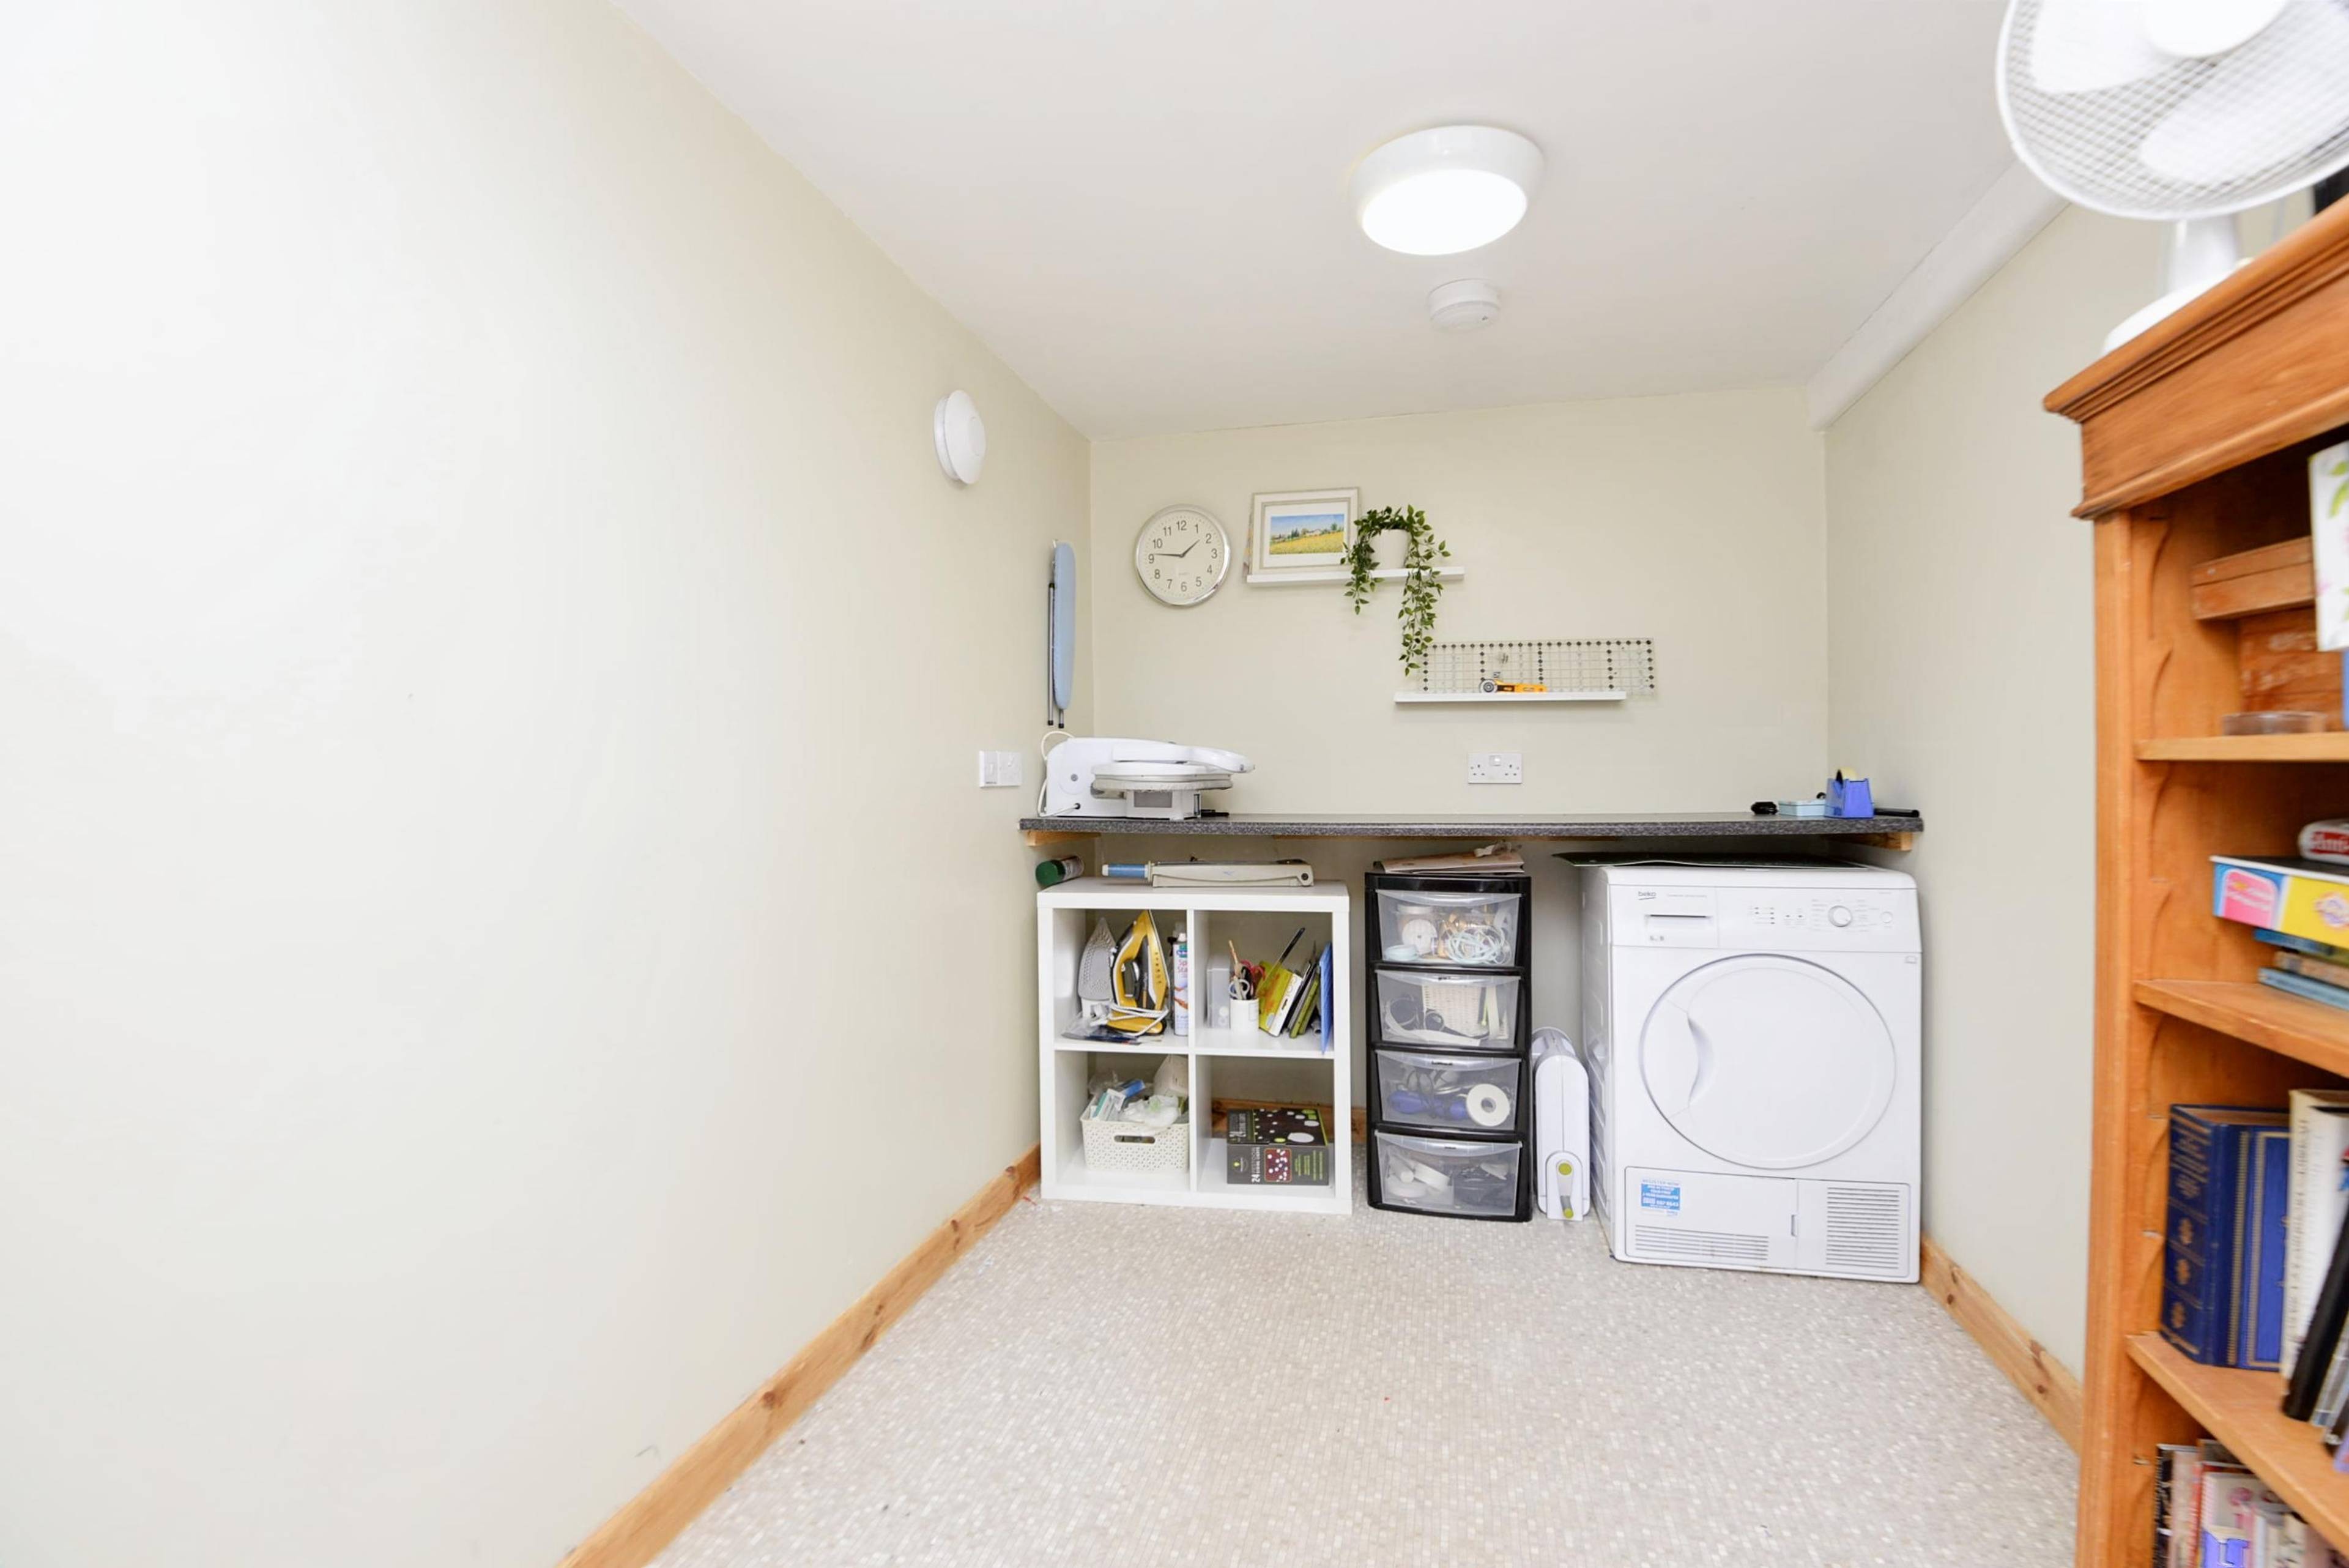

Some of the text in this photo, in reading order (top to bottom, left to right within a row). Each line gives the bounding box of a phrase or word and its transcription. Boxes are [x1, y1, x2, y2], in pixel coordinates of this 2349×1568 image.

[1176, 520, 1187, 531] 12
[1195, 524, 1199, 533] 1
[1163, 526, 1171, 536] 11
[1152, 538, 1163, 549] 10
[1205, 533, 1212, 544] 2
[1211, 548, 1218, 559] 3
[1148, 554, 1155, 564] 9
[1154, 568, 1161, 579] 8
[1206, 565, 1212, 574] 4
[1167, 579, 1173, 589] 7
[1195, 576, 1202, 587] 5
[1181, 582, 1187, 592] 6
[1251, 1174, 1260, 1183] 24
